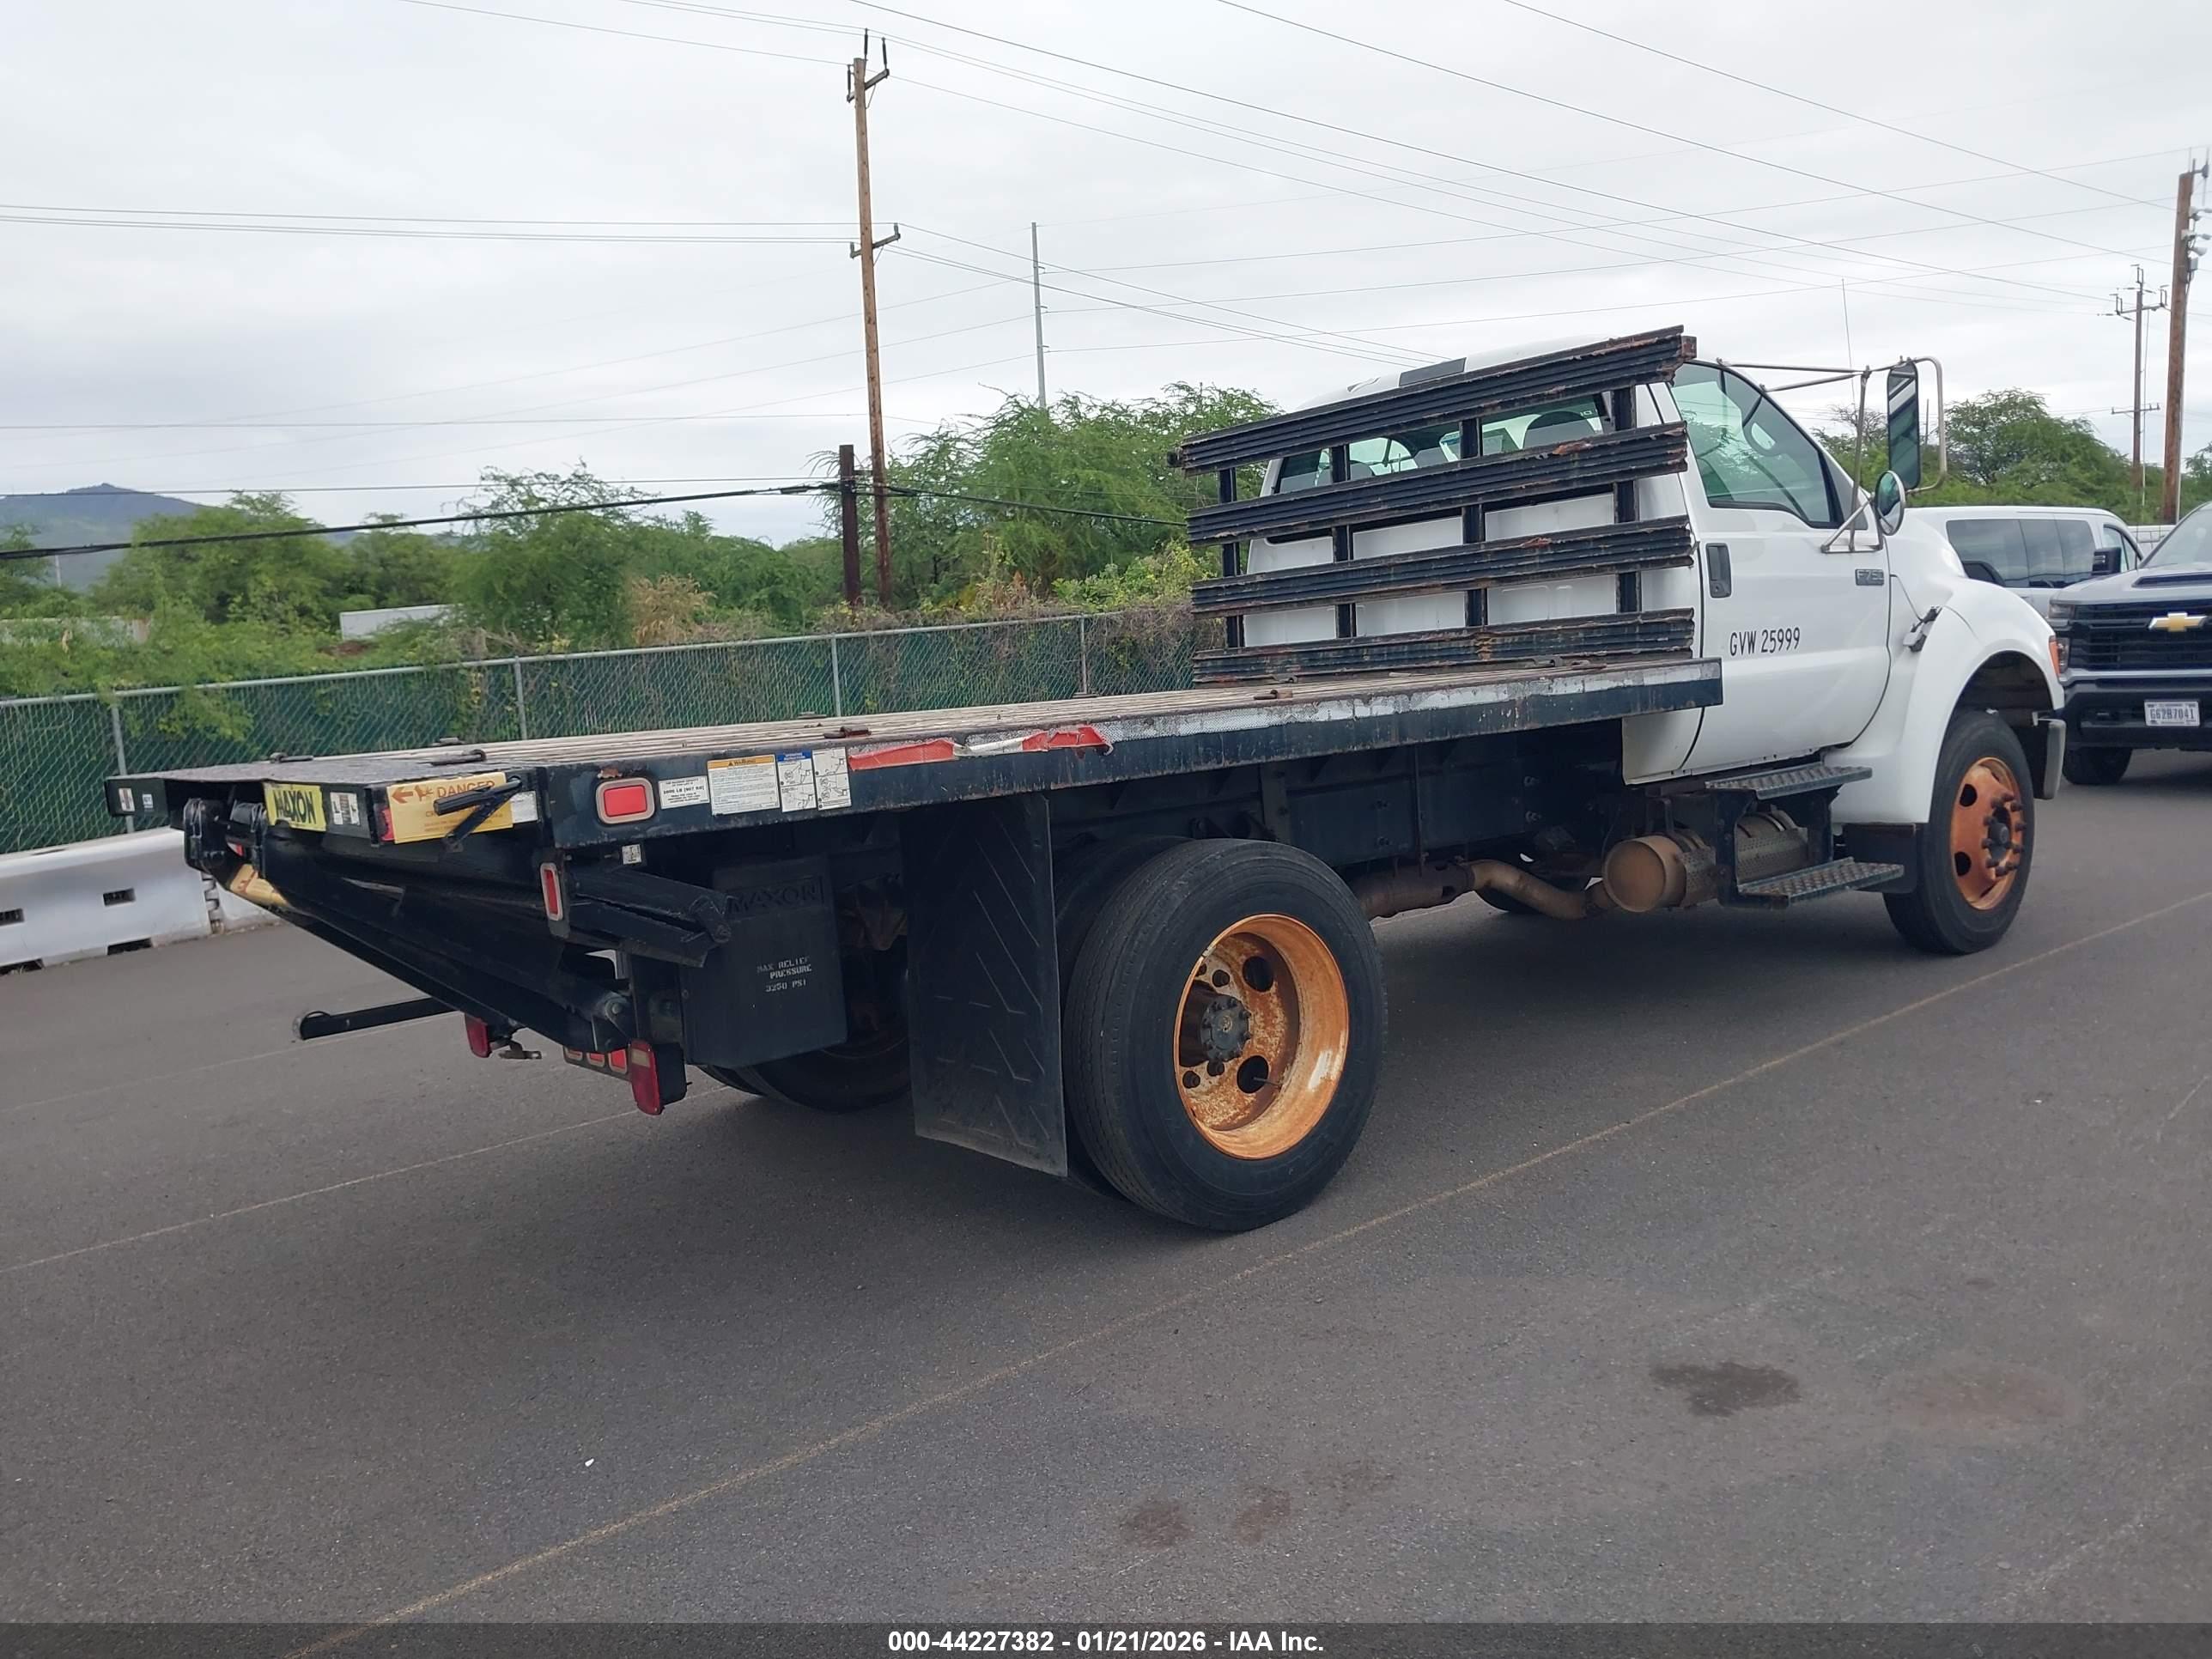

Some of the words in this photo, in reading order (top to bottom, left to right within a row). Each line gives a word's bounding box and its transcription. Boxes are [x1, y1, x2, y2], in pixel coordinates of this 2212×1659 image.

[1729, 630, 1757, 656] GVW
[1760, 627, 1800, 653] 25999
[272, 790, 317, 824] MAXON
[727, 882, 817, 913] MAXON
[757, 963, 775, 973] MAX
[778, 956, 809, 969] RELIEF
[769, 964, 812, 979] PRESSURE
[792, 979, 806, 988] PSI
